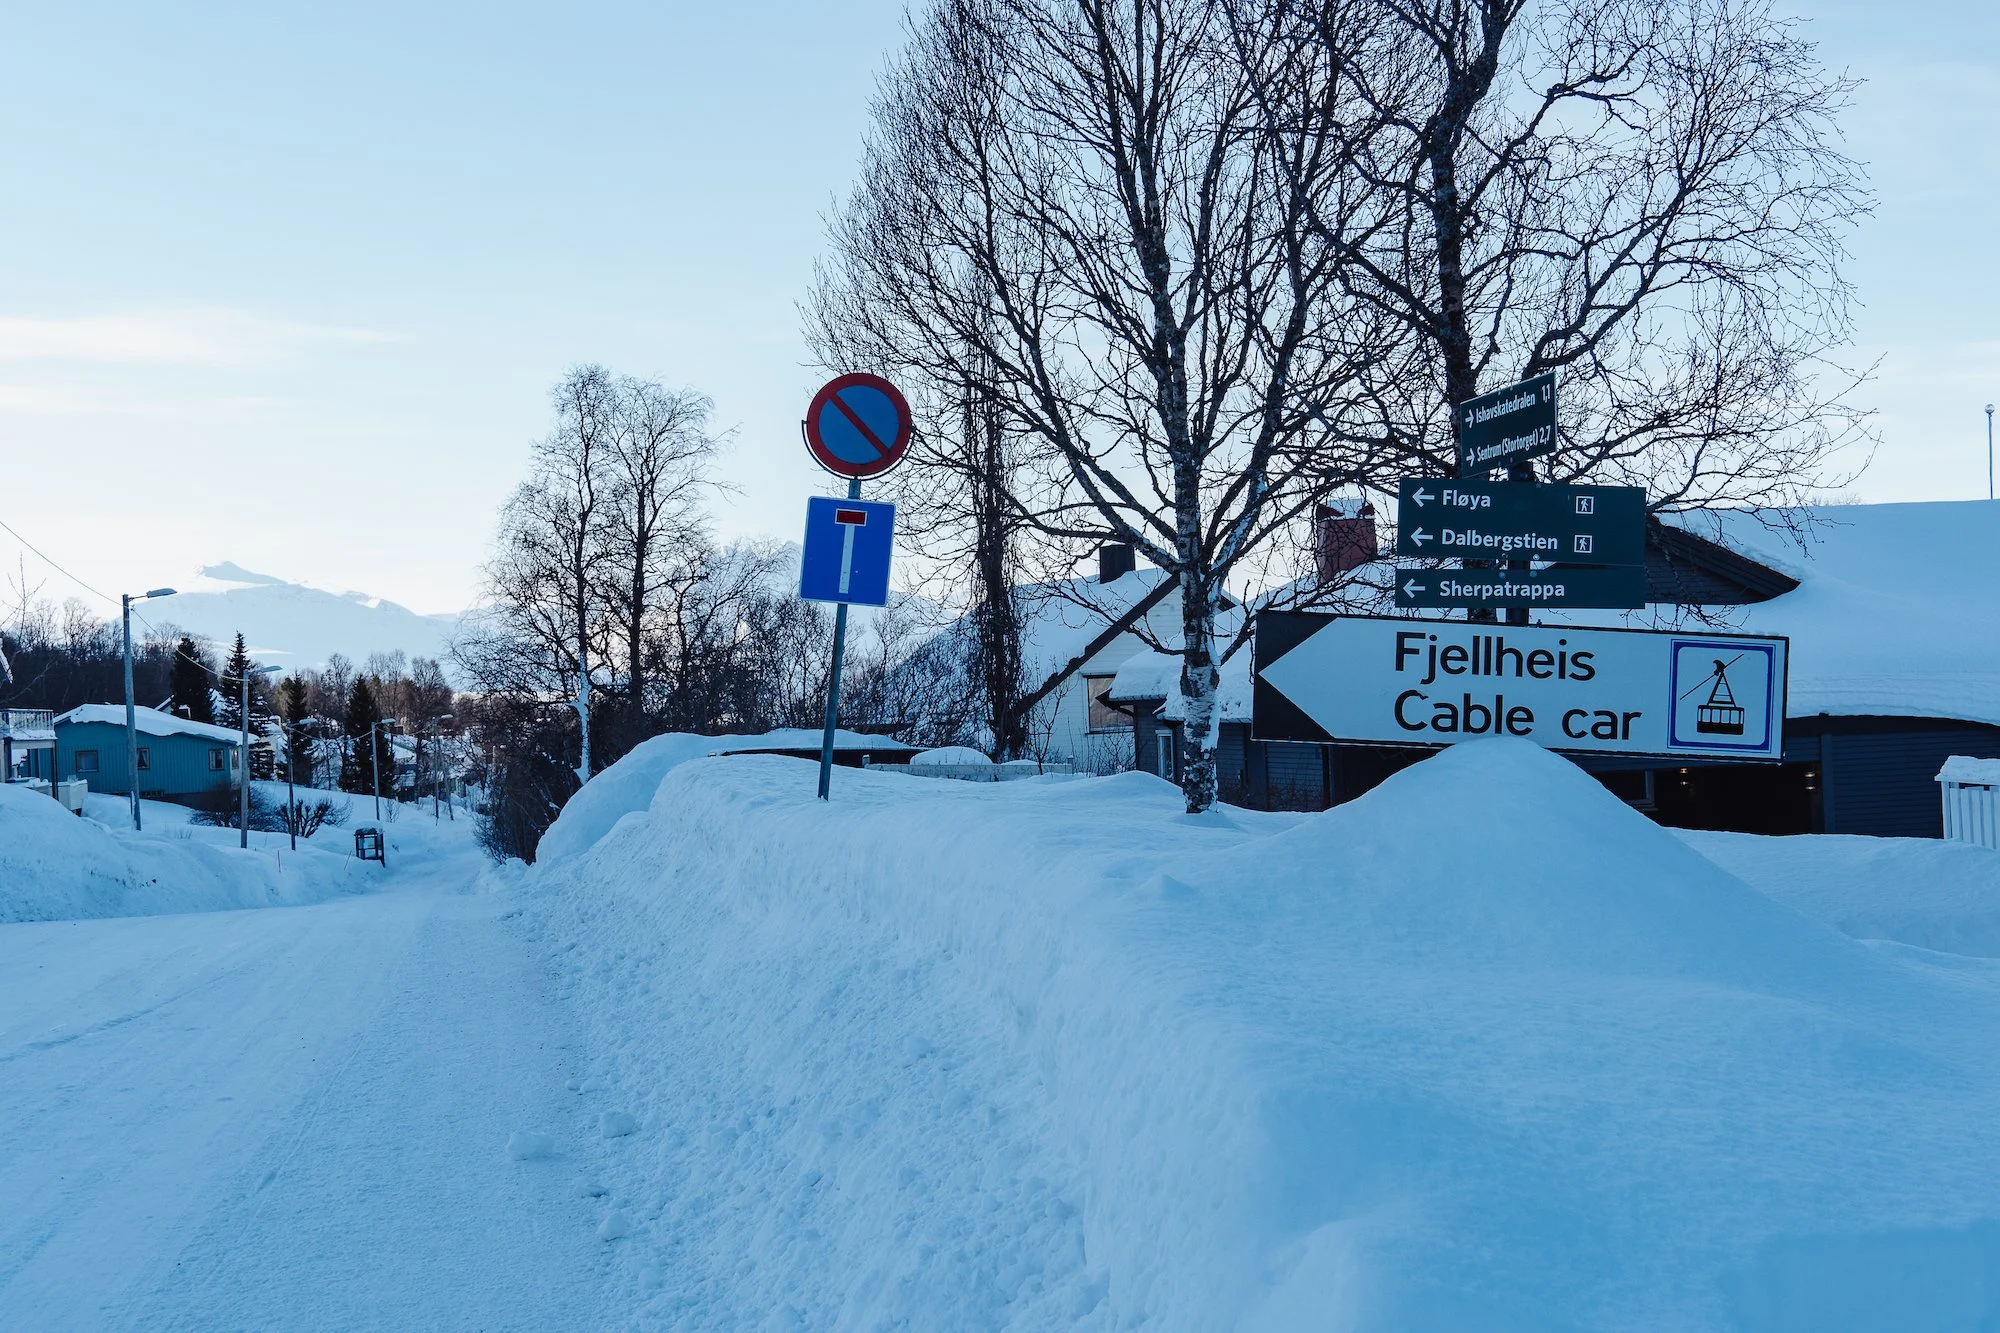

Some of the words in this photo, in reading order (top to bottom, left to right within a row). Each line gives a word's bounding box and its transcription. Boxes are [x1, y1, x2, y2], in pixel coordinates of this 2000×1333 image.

[1476, 391, 1536, 424] Ishavskatedralen
[1476, 443, 1502, 462] Sentrum
[1501, 428, 1538, 456] (Stortorget)
[1539, 424, 1551, 445] 2,7
[1442, 489, 1491, 510] Fløya
[1441, 528, 1558, 551] Dalbergstien
[1439, 580, 1565, 600] Sherpatrappa
[1395, 631, 1596, 685] Fjellheis
[1394, 689, 1535, 736] Cable
[1561, 708, 1643, 741] car
